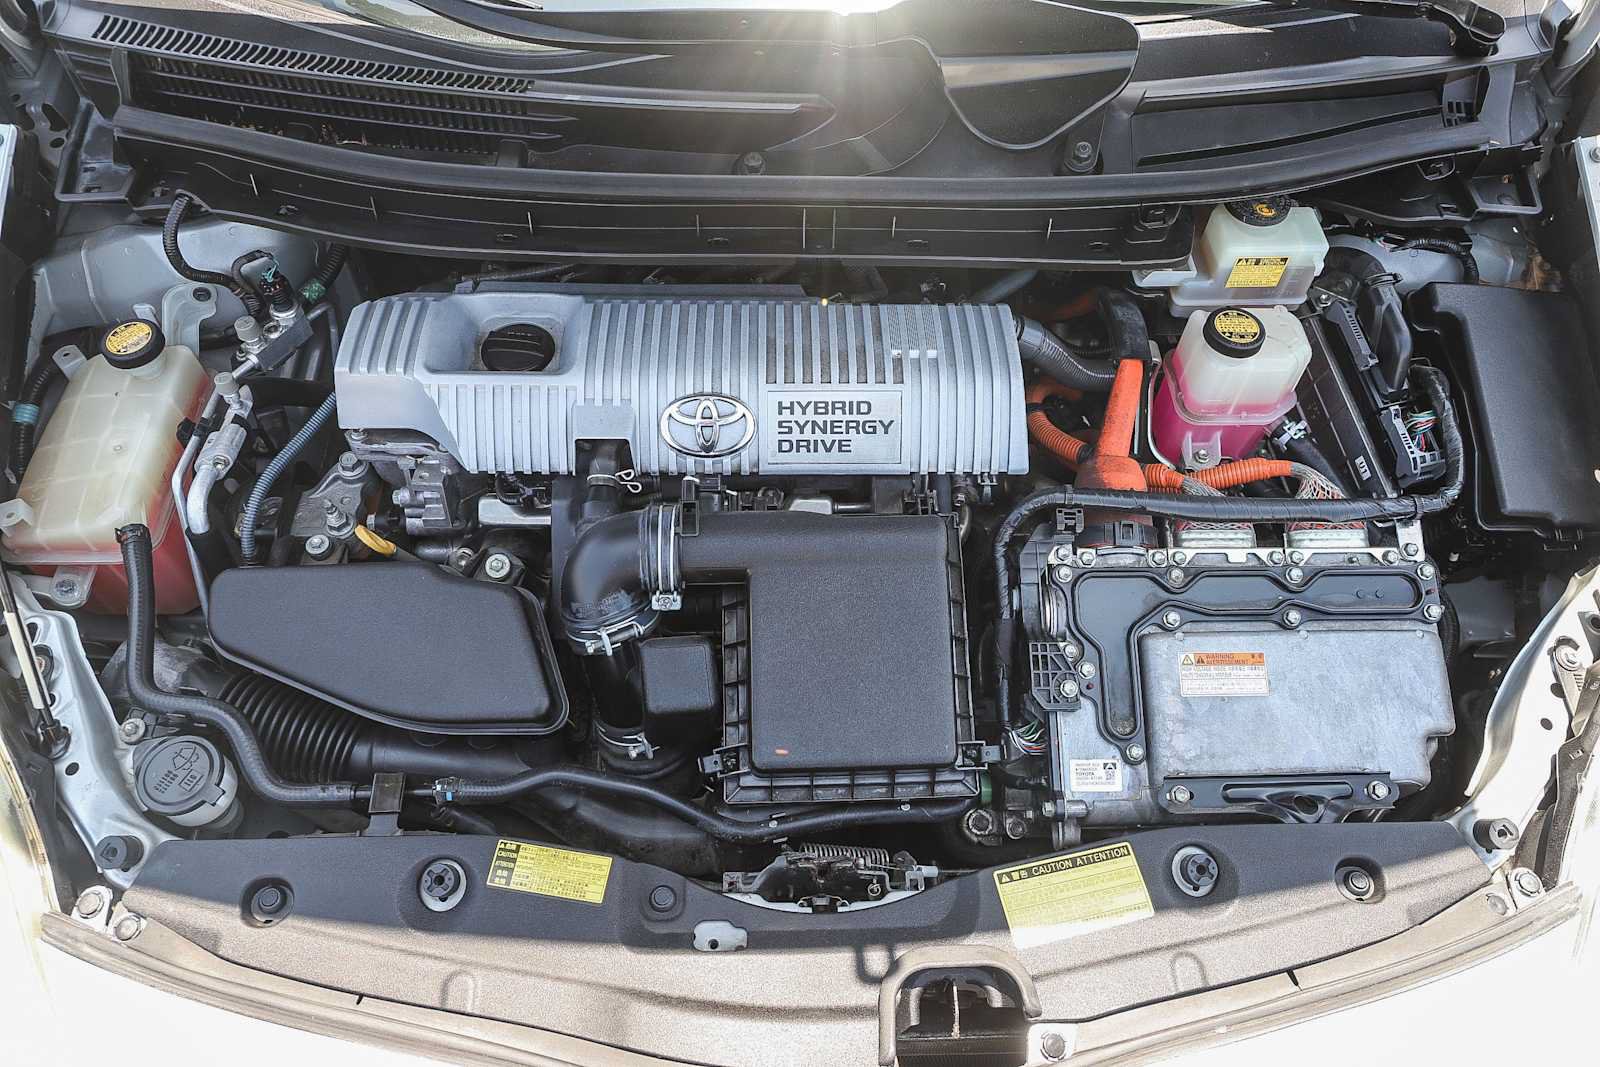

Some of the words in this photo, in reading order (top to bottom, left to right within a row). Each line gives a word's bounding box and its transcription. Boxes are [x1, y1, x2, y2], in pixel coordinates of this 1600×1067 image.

[777, 400, 872, 416] HYBRID
[777, 420, 895, 435] SYNERGY
[777, 439, 852, 454] DRIVE
[1031, 858, 1073, 877] CAUTION
[1076, 846, 1129, 867] ATTENTION
